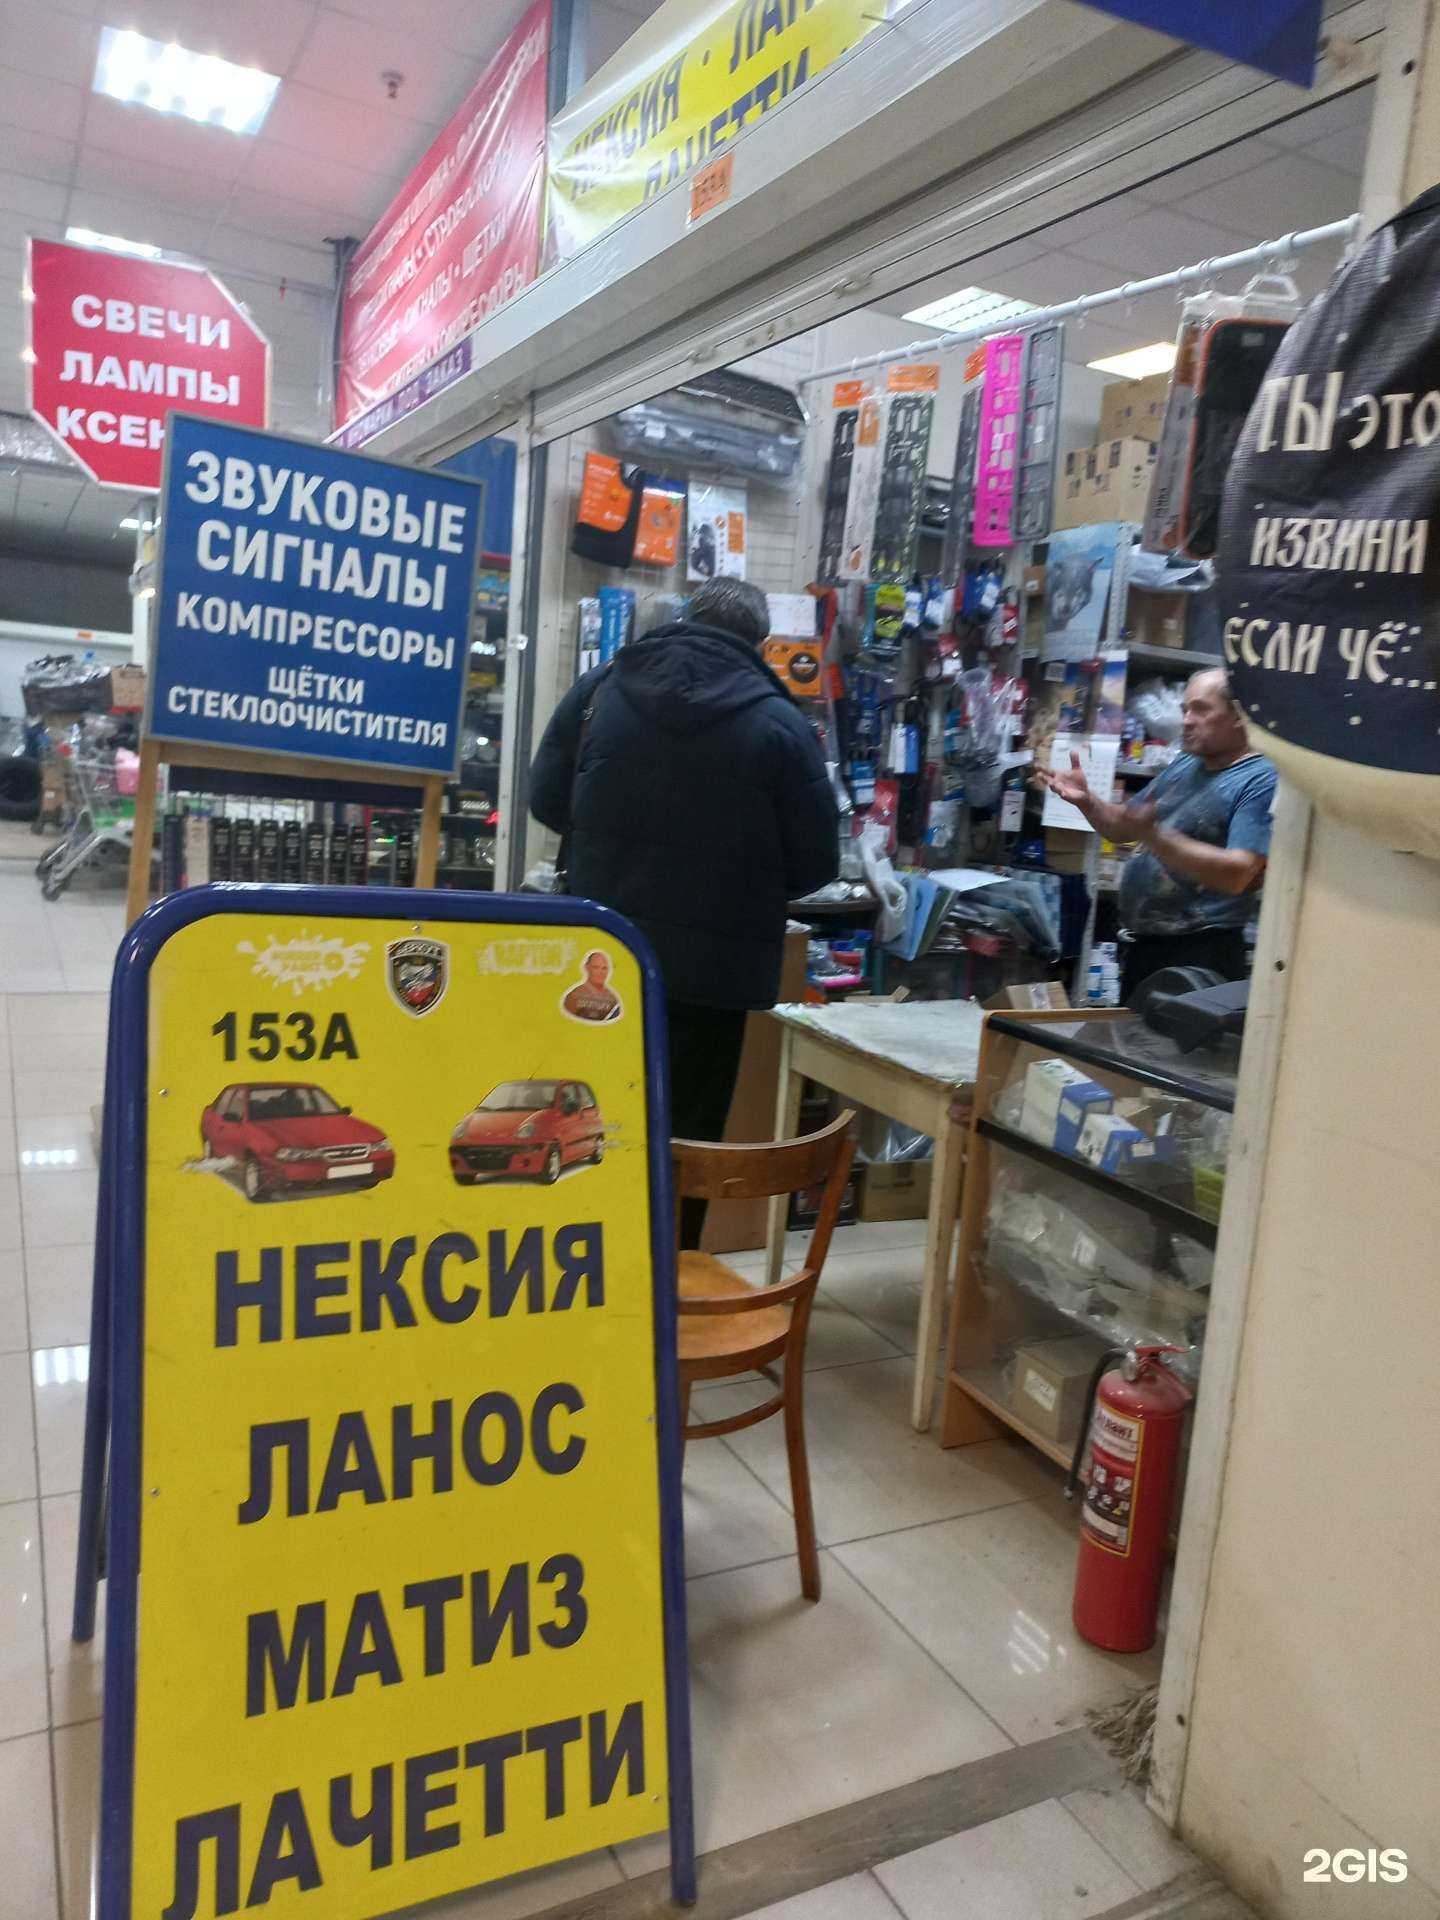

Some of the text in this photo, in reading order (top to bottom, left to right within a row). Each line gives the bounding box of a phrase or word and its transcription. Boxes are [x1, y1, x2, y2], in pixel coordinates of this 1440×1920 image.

[71, 294, 231, 350] СВЕЧИ
[59, 350, 241, 406] ЛАМПЫ
[184, 450, 467, 555] ЗВУКОВЫЕ
[197, 519, 448, 612] СИГНАЛЫ
[1250, 517, 1429, 574] ИЗВИНИ
[176, 591, 456, 671] КОМПРЕССОРЫ
[1223, 616, 1327, 675] ЕСЛИ
[167, 685, 448, 748] СТЕКЛООЧИСТИТЕЛЯ
[268, 664, 365, 706] ЩЁТКИ
[210, 1011, 360, 1062] 153А
[214, 1221, 606, 1349] НЕКСИЯ
[238, 1381, 587, 1526] ЛАНОС
[245, 1552, 589, 1718] МАТИЗ
[161, 1700, 646, 1920] ЛАЧЕТТИ
